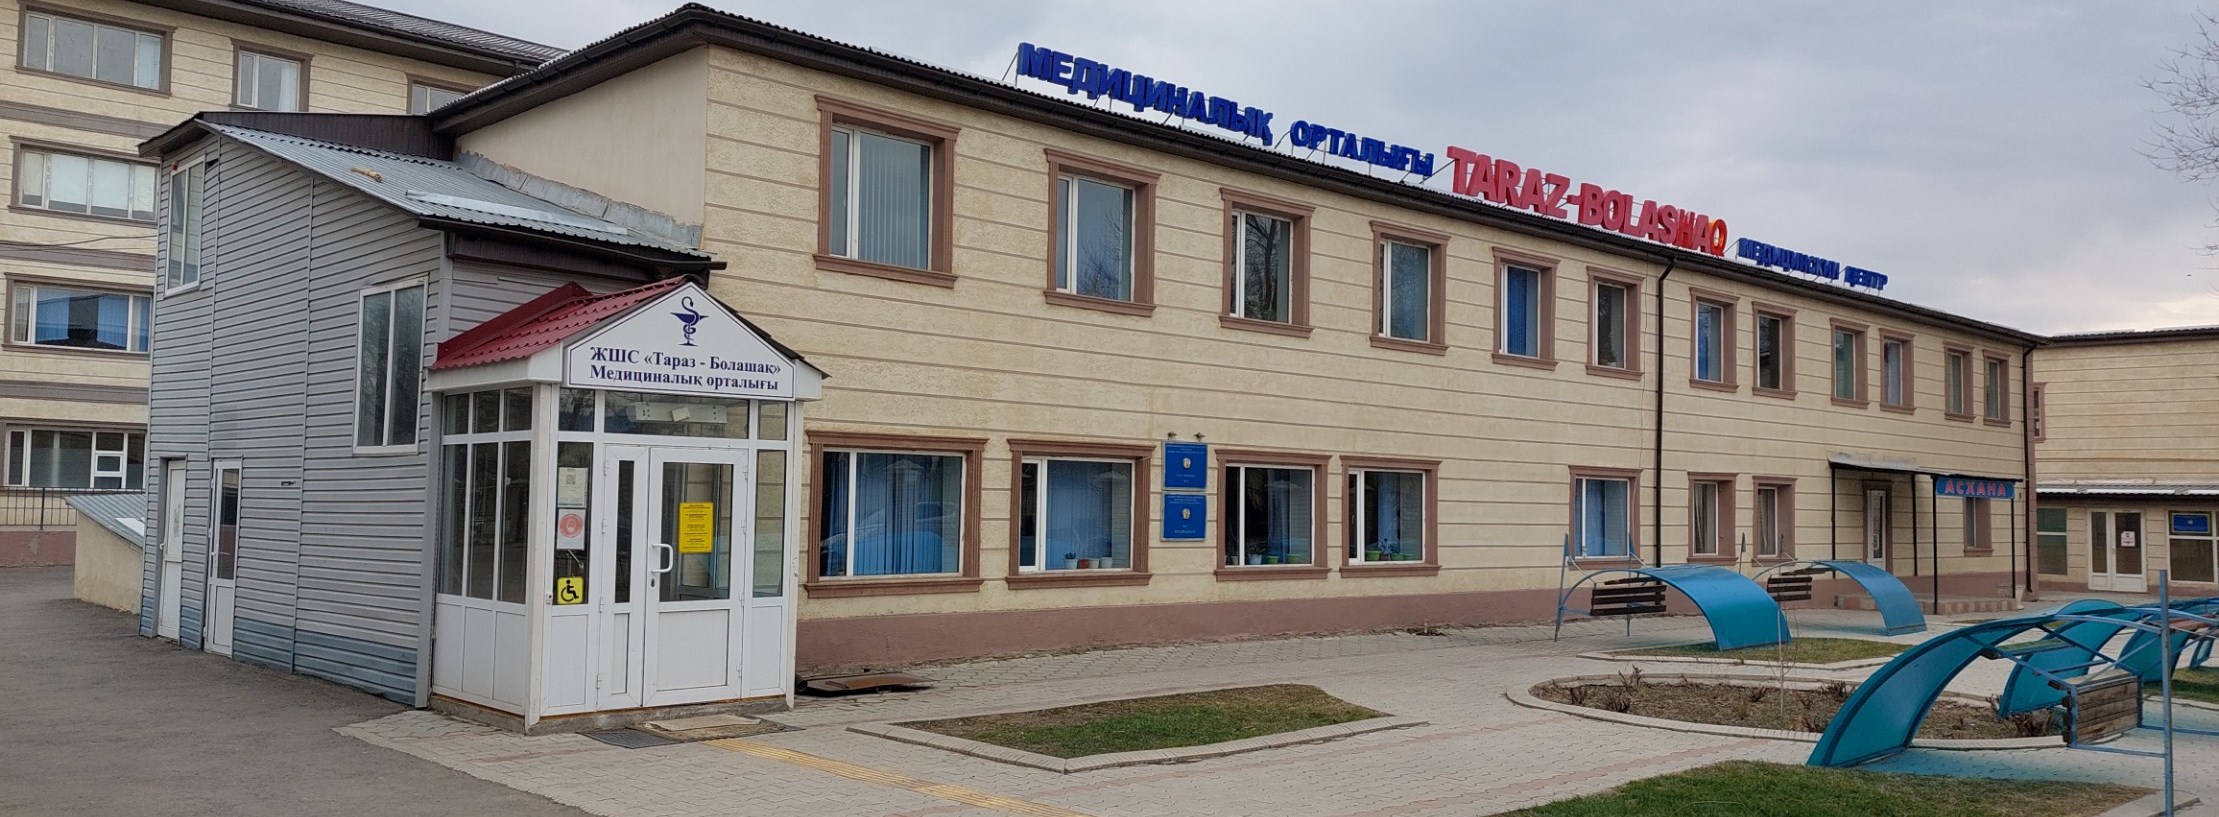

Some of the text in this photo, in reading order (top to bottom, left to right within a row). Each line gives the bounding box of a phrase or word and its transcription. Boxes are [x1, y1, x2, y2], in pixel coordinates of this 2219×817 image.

[1018, 43, 1434, 177] МЕДИЦИНАЛЫҚ ОРТАЛЫҒЫ
[1446, 145, 1728, 257] TARAZ-BOLASHAQ
[1844, 265, 1888, 290] ЦЕНТР
[590, 346, 640, 364] ЖШС
[644, 352, 696, 369] «Тараз
[590, 365, 779, 391] Медициналық орталығы
[1944, 479, 2007, 497] АСХАНА
